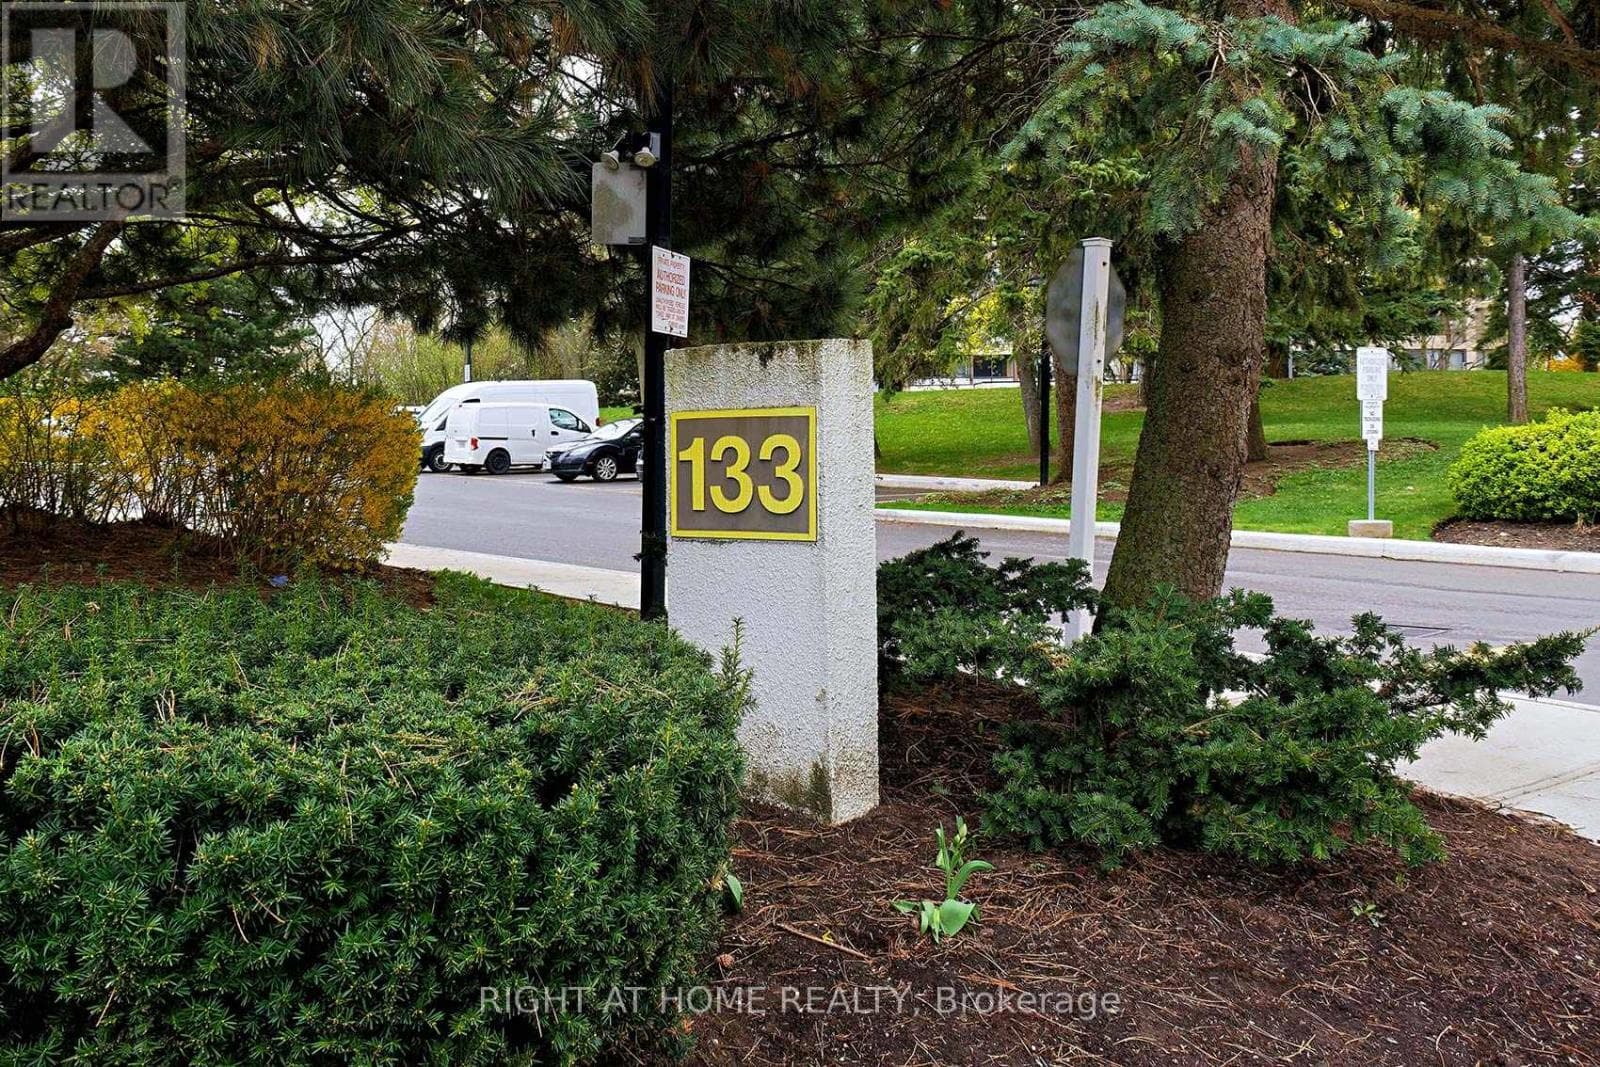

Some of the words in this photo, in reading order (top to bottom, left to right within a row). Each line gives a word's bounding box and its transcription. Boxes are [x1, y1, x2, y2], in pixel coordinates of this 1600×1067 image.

[656, 269, 686, 286] AUTHORIZED
[655, 281, 675, 296] PARKING
[678, 433, 805, 515] 133
